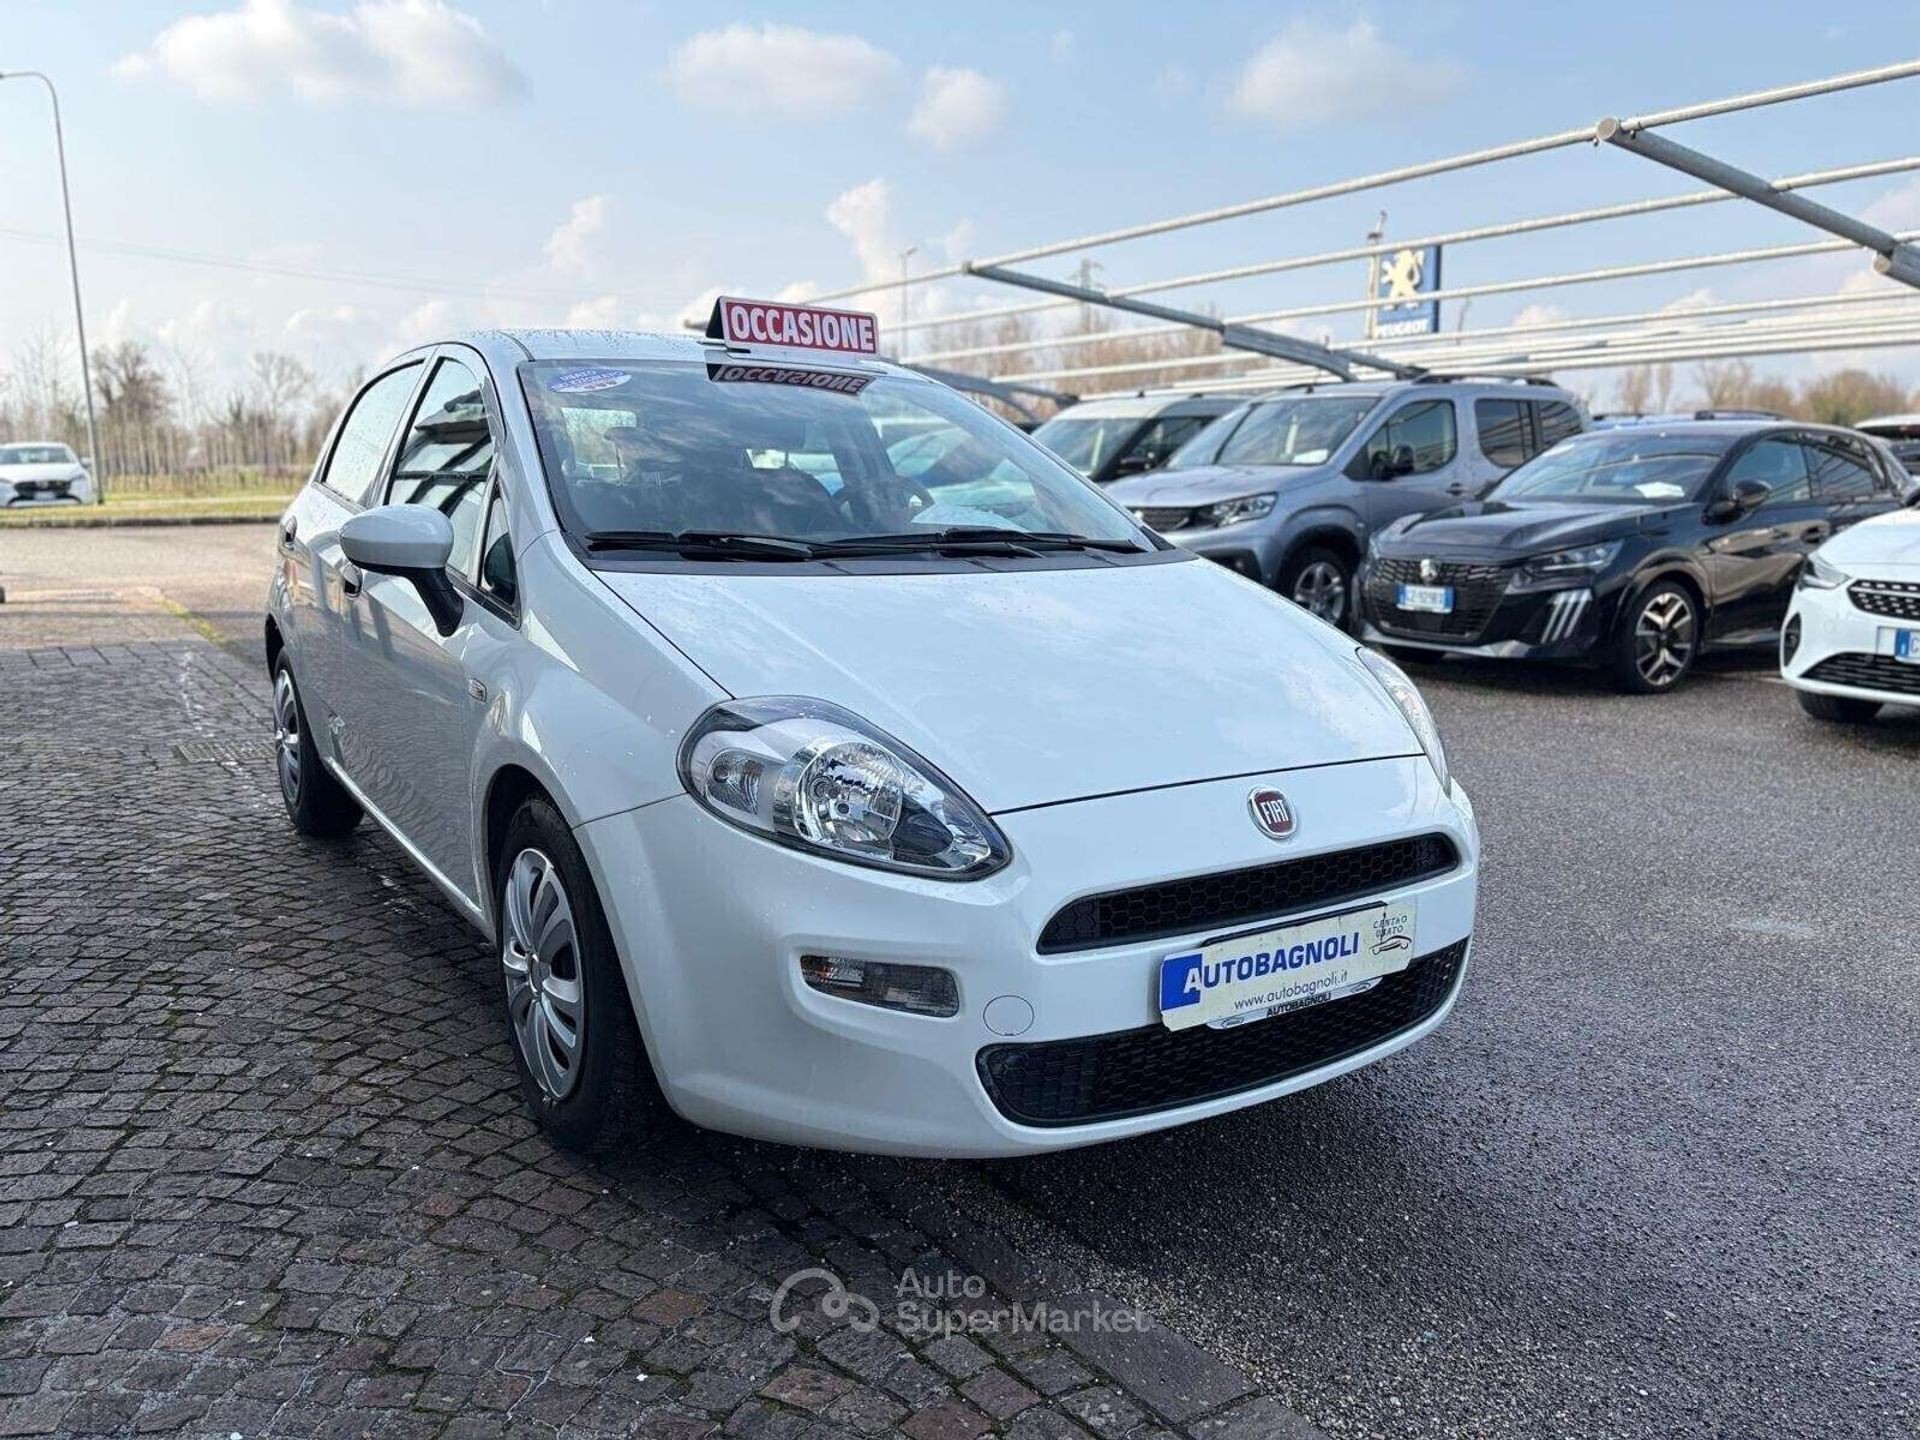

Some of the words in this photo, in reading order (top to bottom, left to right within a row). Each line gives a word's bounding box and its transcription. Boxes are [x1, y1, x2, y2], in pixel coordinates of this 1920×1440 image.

[730, 305, 874, 350] OCCASIONE
[1260, 799, 1289, 824] FIAT
[1183, 931, 1360, 994] AUTOBAGNOLI
[1233, 969, 1348, 1009] www.autobagnoli.it
[1265, 992, 1332, 1017] AUTOBAGNOLI
